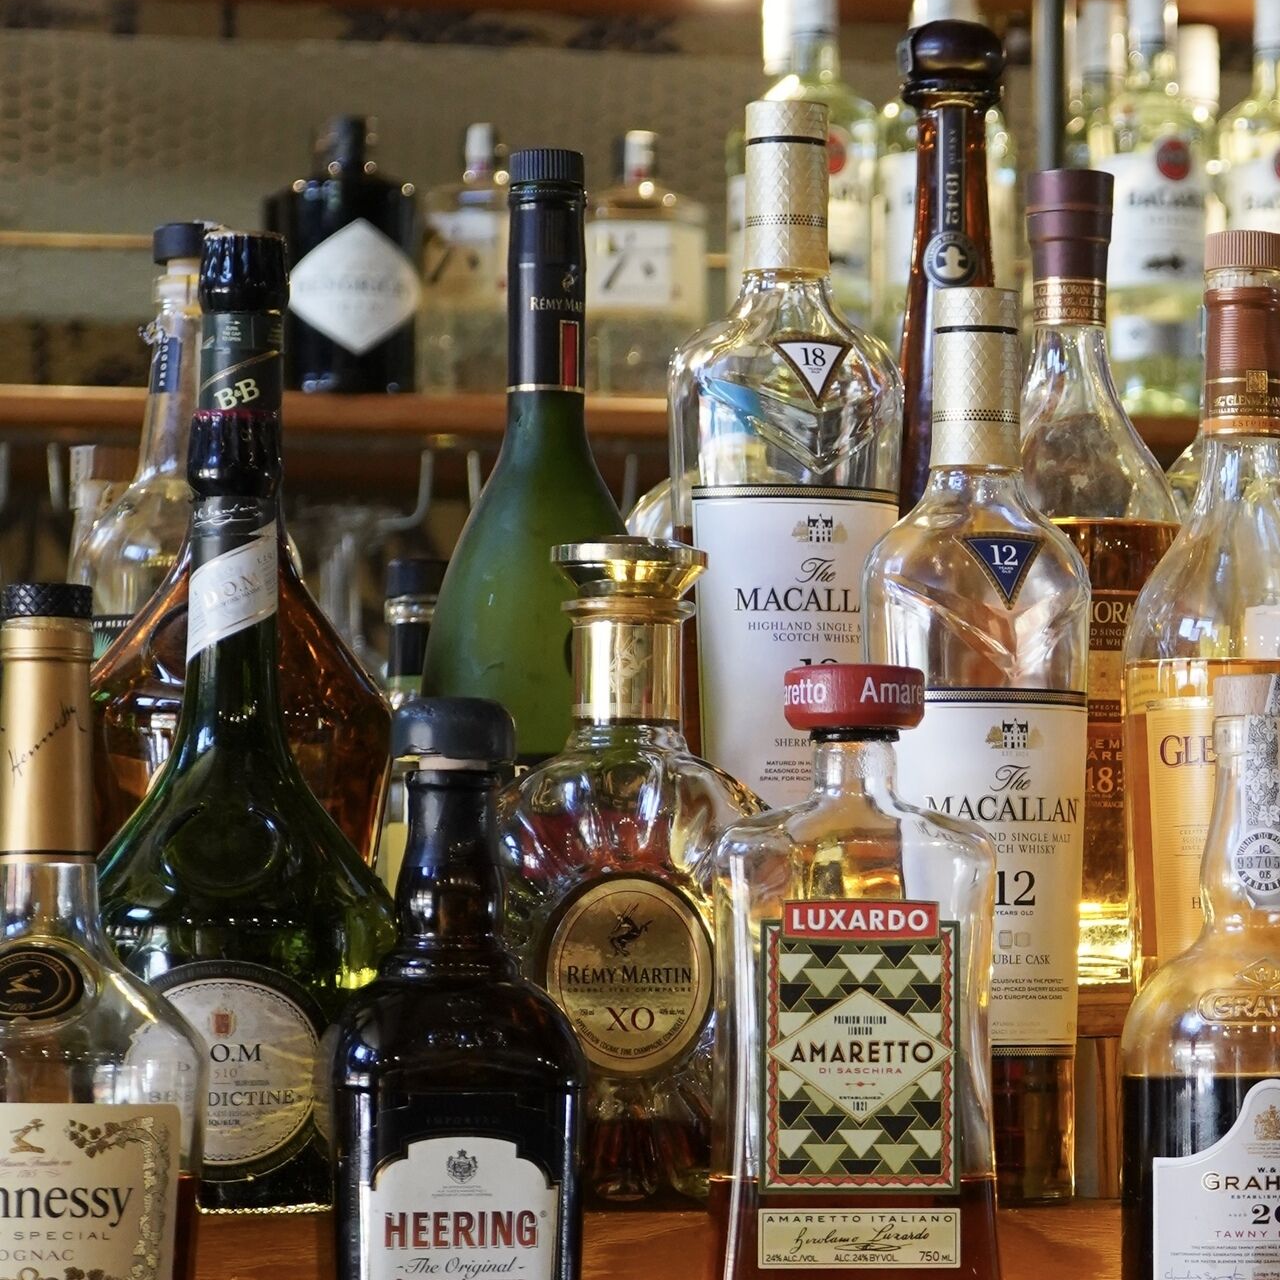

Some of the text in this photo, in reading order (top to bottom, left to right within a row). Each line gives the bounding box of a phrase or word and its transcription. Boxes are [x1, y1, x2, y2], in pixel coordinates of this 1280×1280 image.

[530, 295, 561, 311] RÉMY
[800, 347, 826, 367] 18
[214, 377, 261, 410] B&B
[990, 544, 1019, 566] 12
[795, 557, 836, 583] The
[748, 621, 854, 633] HIGHLAND SINGLE
[773, 632, 820, 642] SCOTCH
[990, 765, 1032, 791] The
[926, 796, 1080, 824] MACALLAN
[1011, 832, 1071, 843] SINGLE MALT
[1020, 844, 1056, 854] WHISKY
[995, 870, 1036, 907] 12
[792, 909, 930, 931] LUXARDO
[1025, 954, 1051, 965] CASK
[567, 964, 692, 984] RÉMY MARTIN
[605, 1006, 655, 1032] XO
[790, 1040, 934, 1063] AMARETTO
[853, 1101, 867, 1111] 1821
[767, 1215, 953, 1223] AMARETTO ITALIANO
[14, 1231, 111, 1241] SPECIAL
[384, 1210, 539, 1249] HEERING
[1215, 1230, 1268, 1238] TAWNY
[919, 1251, 940, 1262] 750
